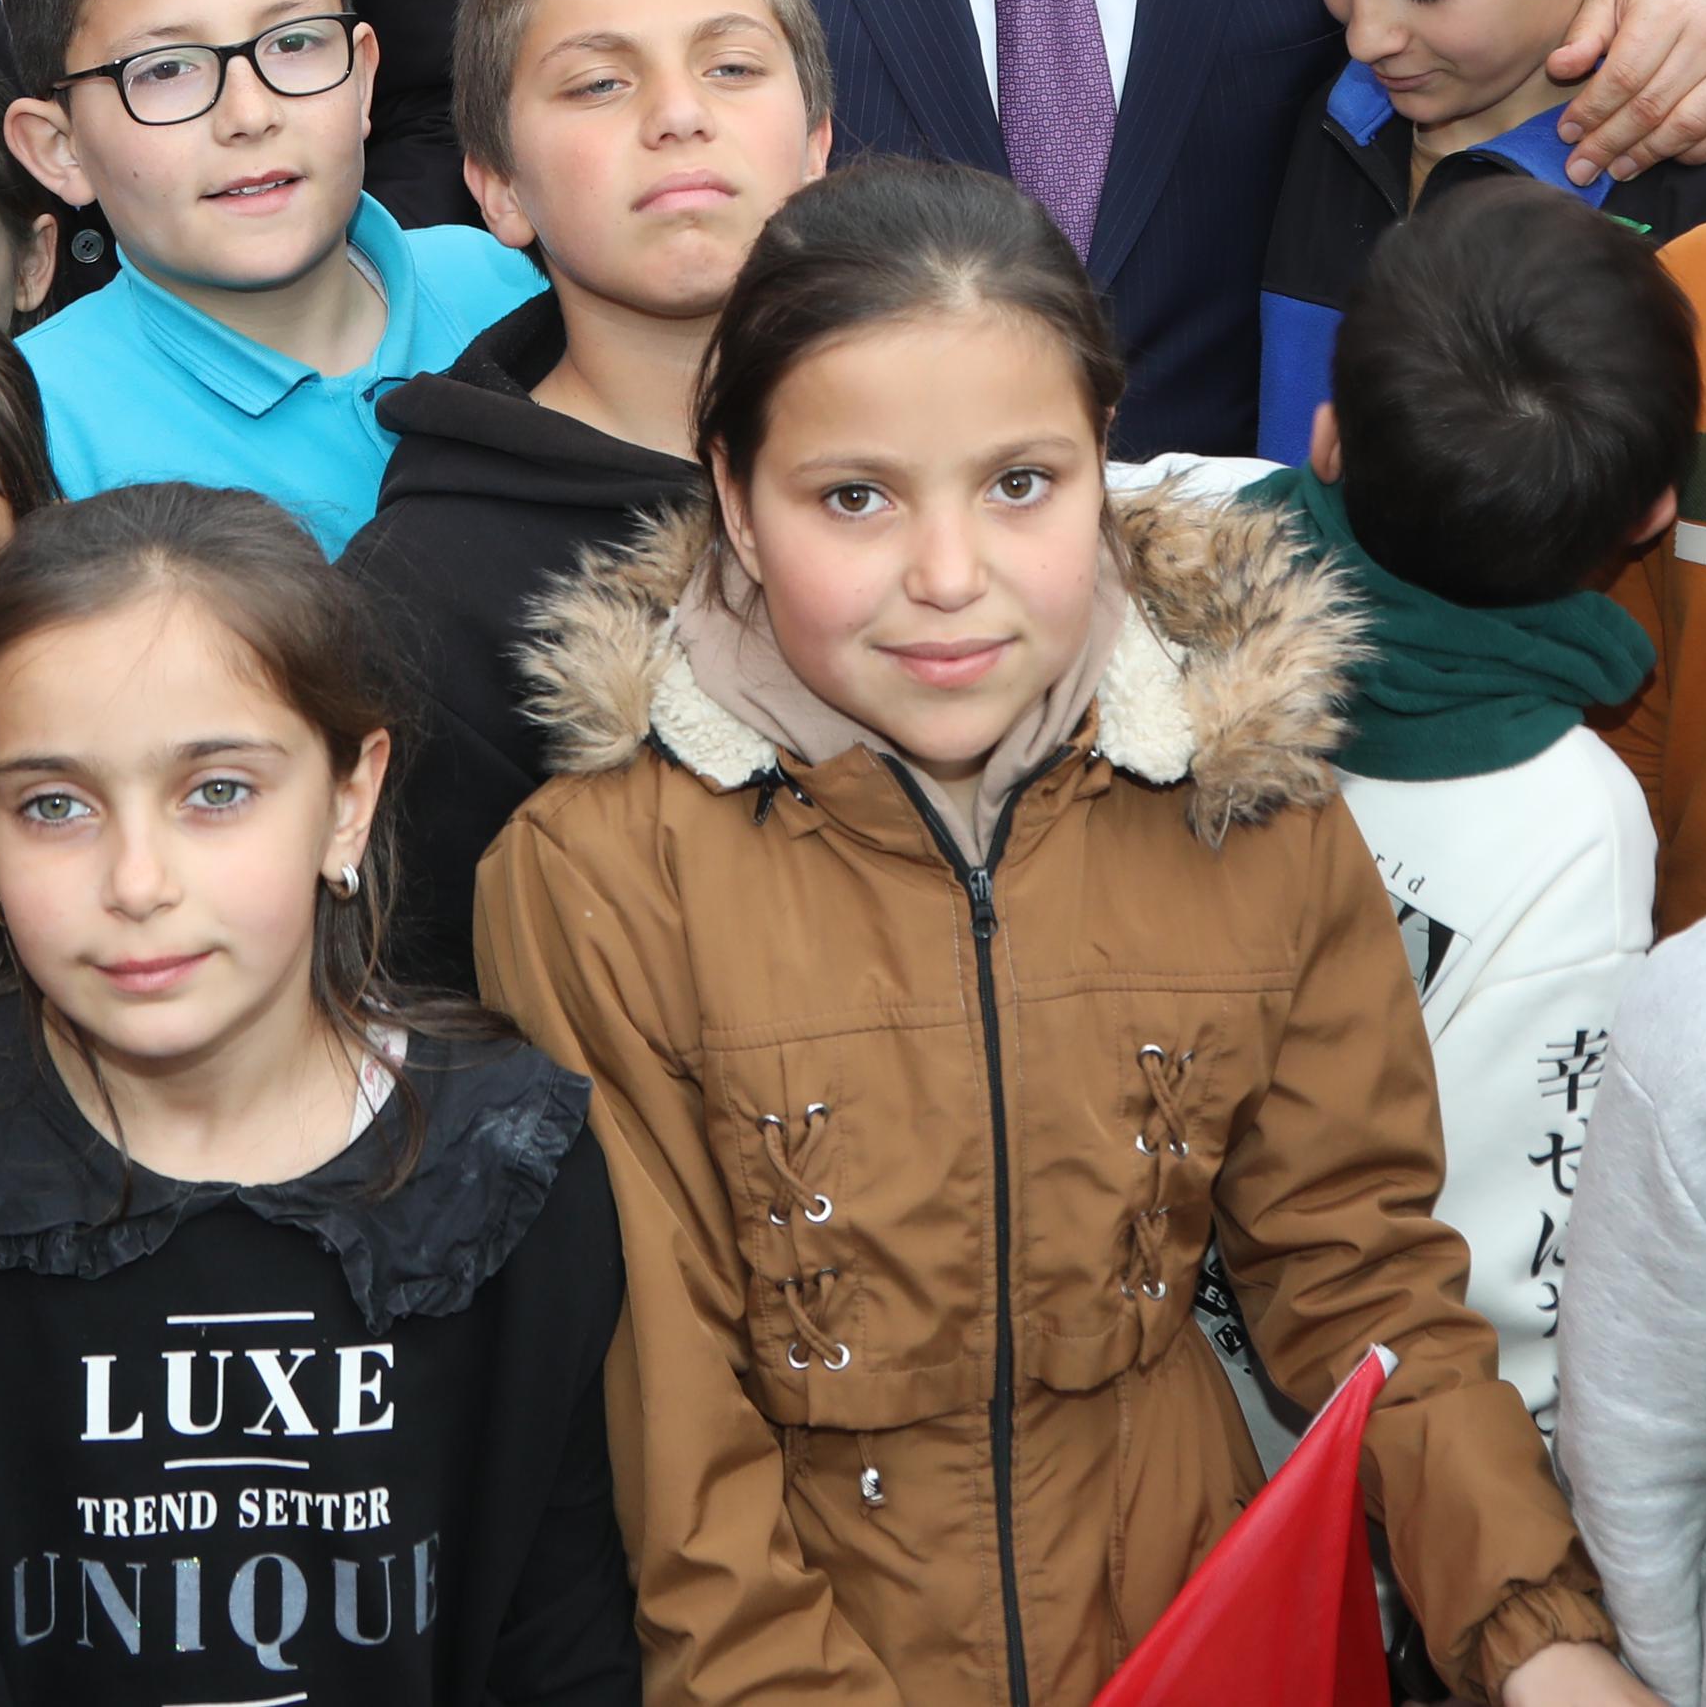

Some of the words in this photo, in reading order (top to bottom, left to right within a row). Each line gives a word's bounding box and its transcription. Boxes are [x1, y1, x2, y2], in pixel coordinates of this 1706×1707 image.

[80, 1343, 394, 1442] LUXE
[77, 1491, 218, 1538] TREND
[238, 1487, 392, 1532] SETTER
[13, 1531, 441, 1672] UNIQUE
